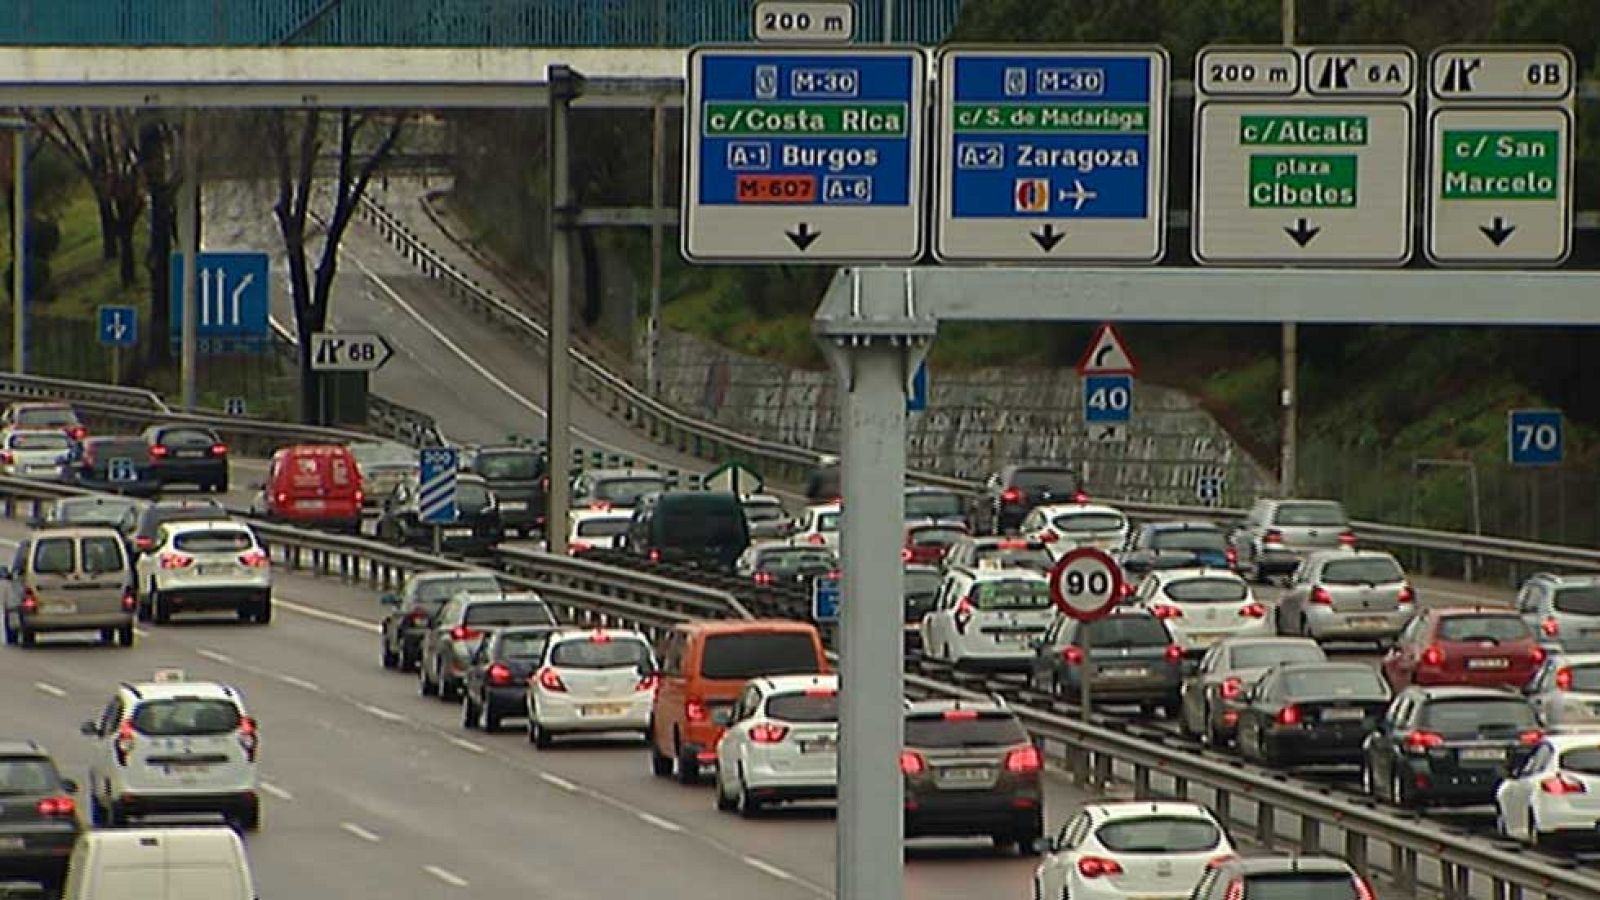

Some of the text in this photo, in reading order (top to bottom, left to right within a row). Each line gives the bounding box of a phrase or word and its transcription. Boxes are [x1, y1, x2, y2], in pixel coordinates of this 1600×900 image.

[764, 12, 843, 30] 200 m
[796, 72, 854, 92] M-30
[1041, 72, 1100, 92] M-30
[1211, 66, 1288, 82] 200 m
[1367, 64, 1401, 82] 6A
[1527, 64, 1561, 84] 6B
[710, 107, 901, 131] c/Costa Rica
[1010, 108, 1035, 126] de
[1042, 108, 1144, 131] Madariaga
[1243, 117, 1364, 143] c/Alcalá
[732, 145, 878, 170] A-1 Burgos
[1497, 138, 1545, 157] San
[963, 146, 1140, 171] A-2 Zaragoza
[1275, 160, 1331, 177] plaza
[739, 178, 868, 198] M-607 A-6
[1445, 171, 1554, 193] Marcelo
[1252, 182, 1354, 205] Cibeles
[348, 343, 375, 362] 6B
[1088, 387, 1129, 411] 40
[1516, 424, 1557, 452] 70
[1066, 571, 1109, 597] 90
